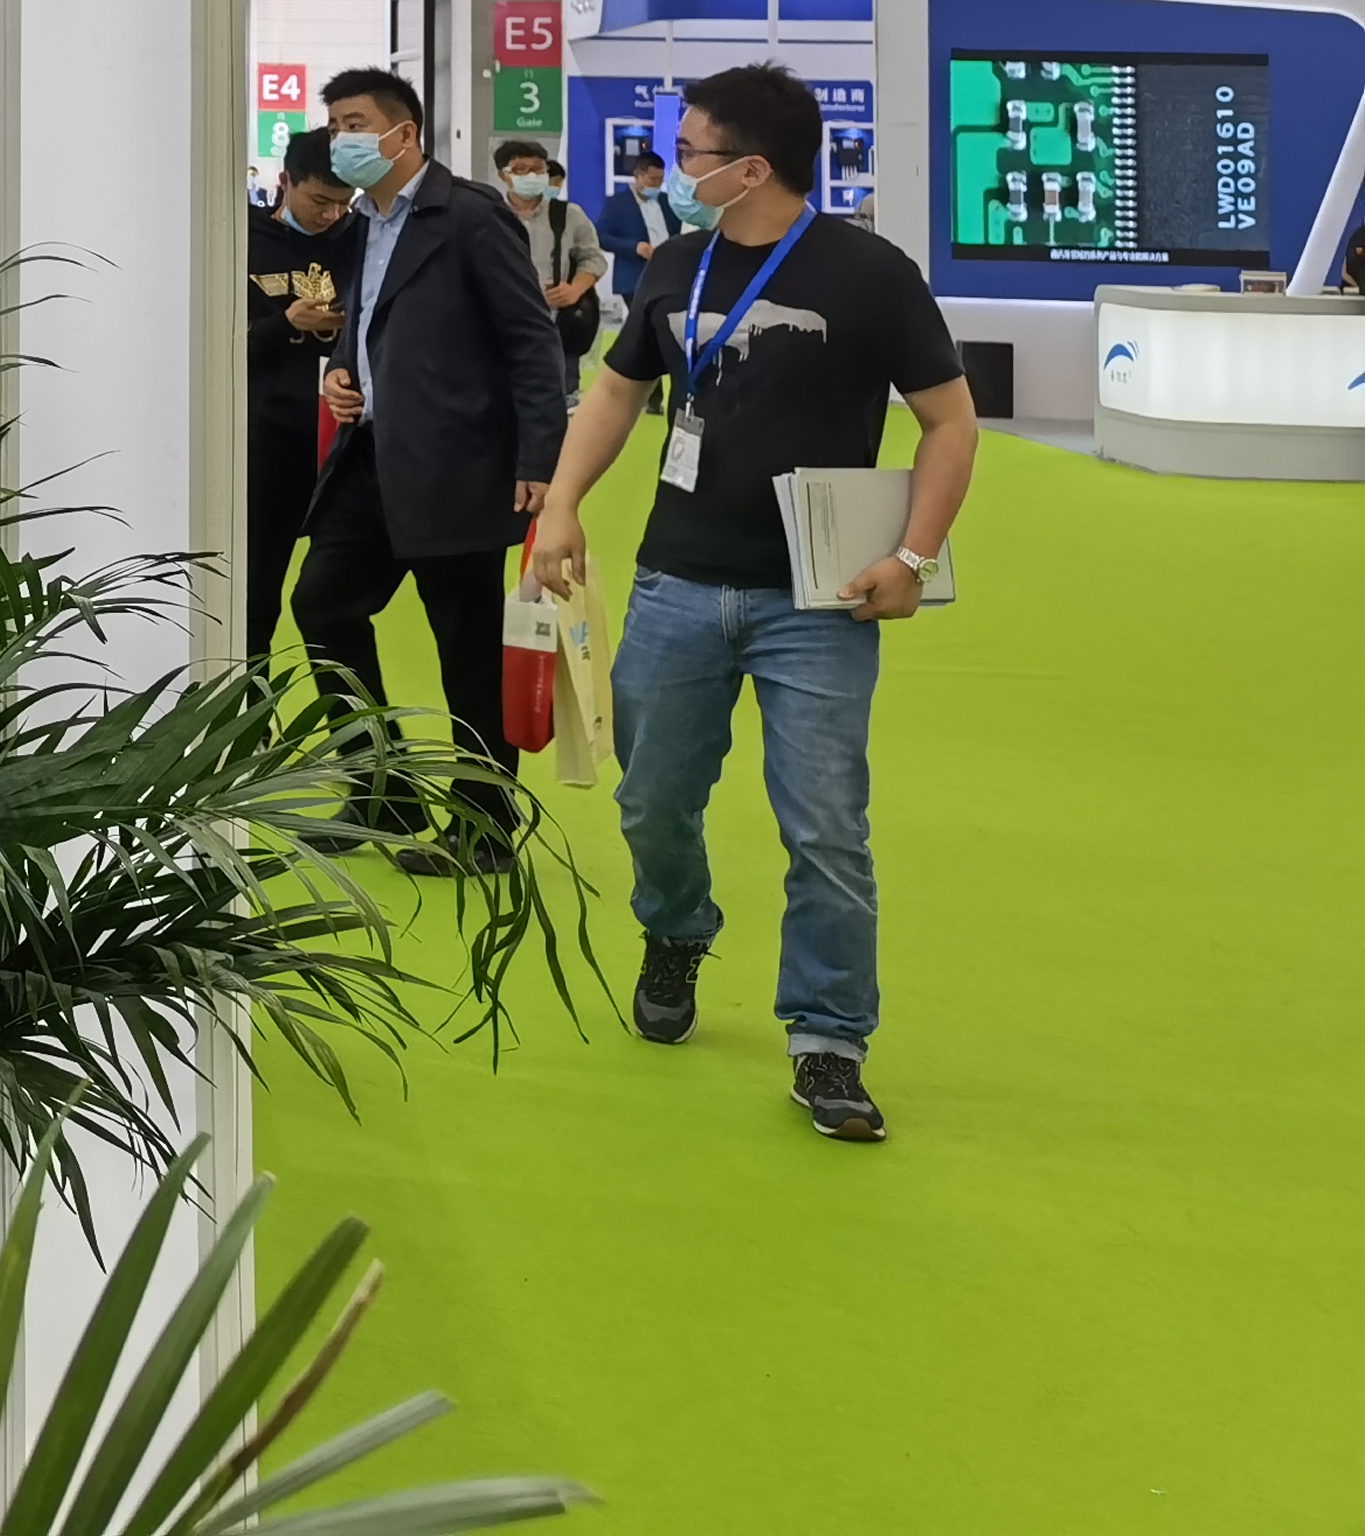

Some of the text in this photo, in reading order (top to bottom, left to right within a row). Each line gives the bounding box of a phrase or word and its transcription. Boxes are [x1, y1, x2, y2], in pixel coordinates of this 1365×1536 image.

[505, 16, 554, 51] E5
[262, 73, 301, 101] E4
[519, 82, 541, 114] 3
[272, 121, 291, 147] 8
[1236, 121, 1257, 230] VE09AD
